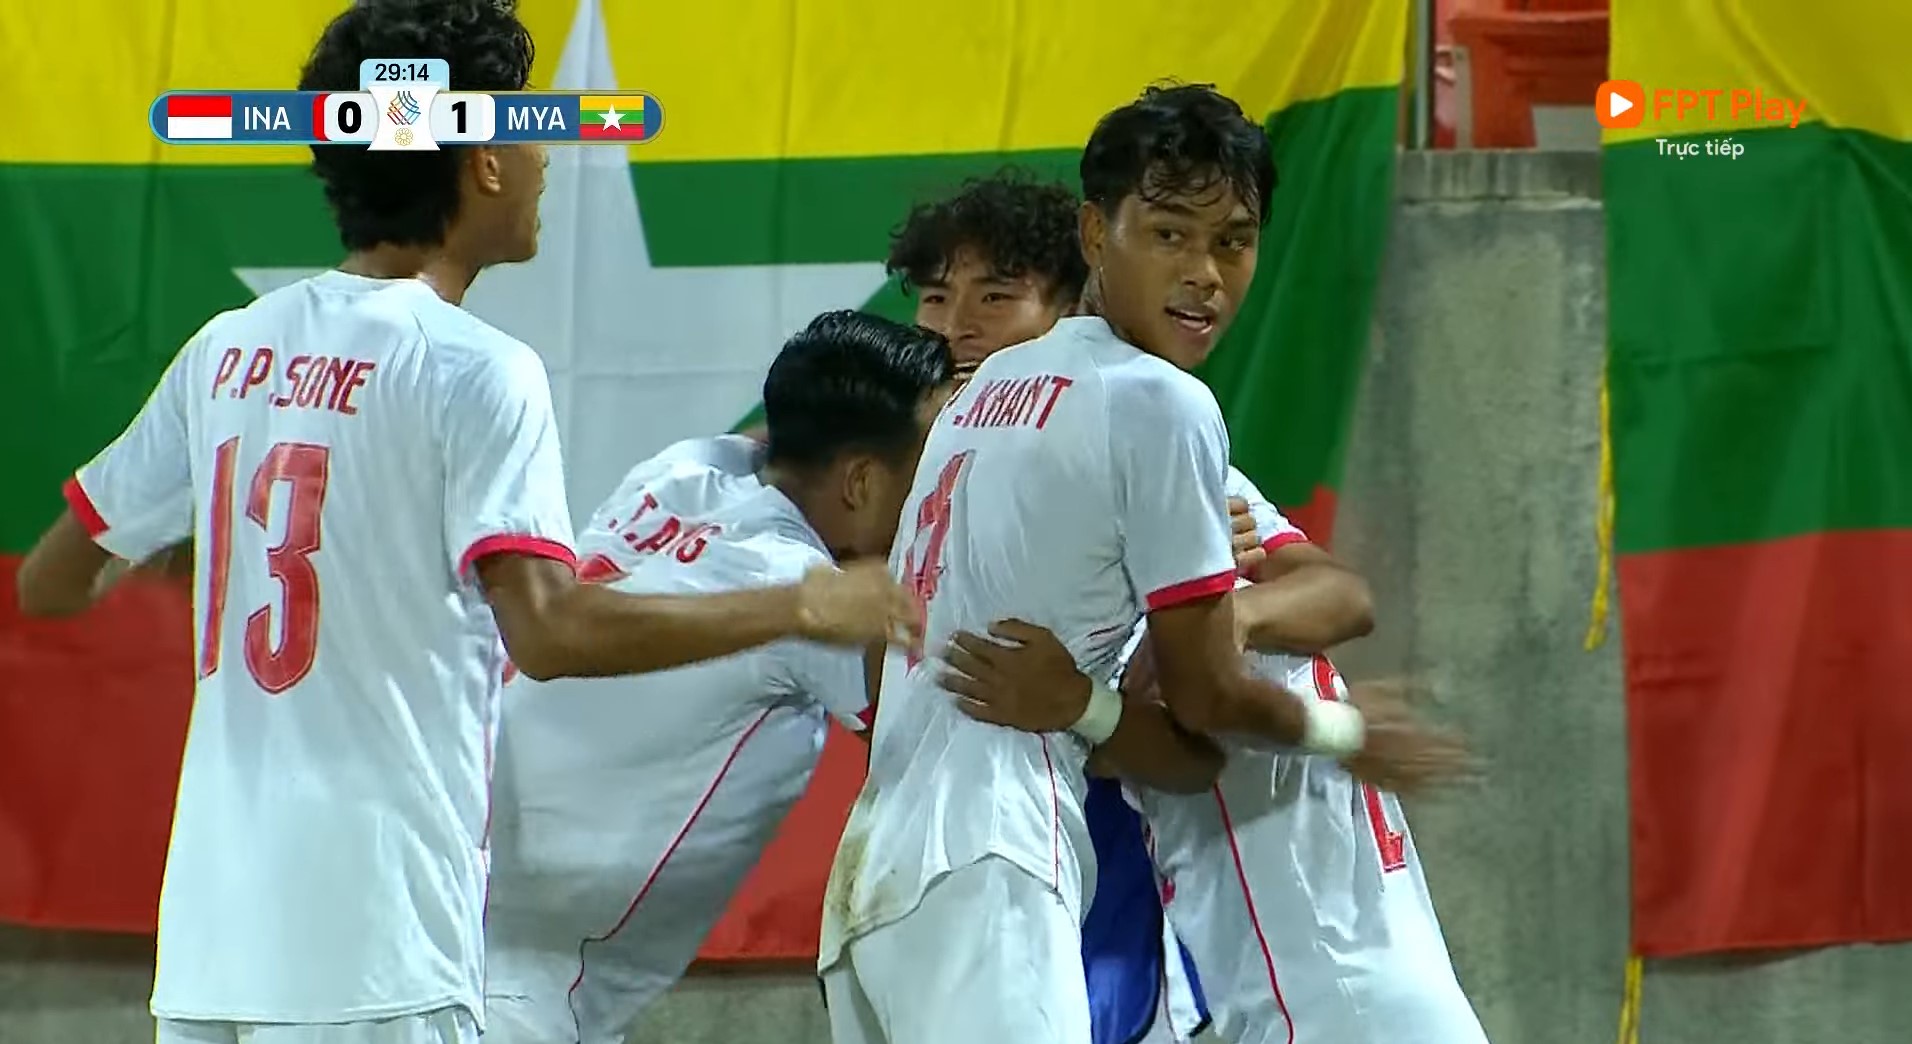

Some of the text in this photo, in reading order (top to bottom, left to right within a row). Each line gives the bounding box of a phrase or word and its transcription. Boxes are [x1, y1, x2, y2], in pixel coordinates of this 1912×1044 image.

[211, 347, 376, 415] P.P.SONE
[946, 374, 1073, 430] .KHANT
[199, 436, 331, 694] 13
